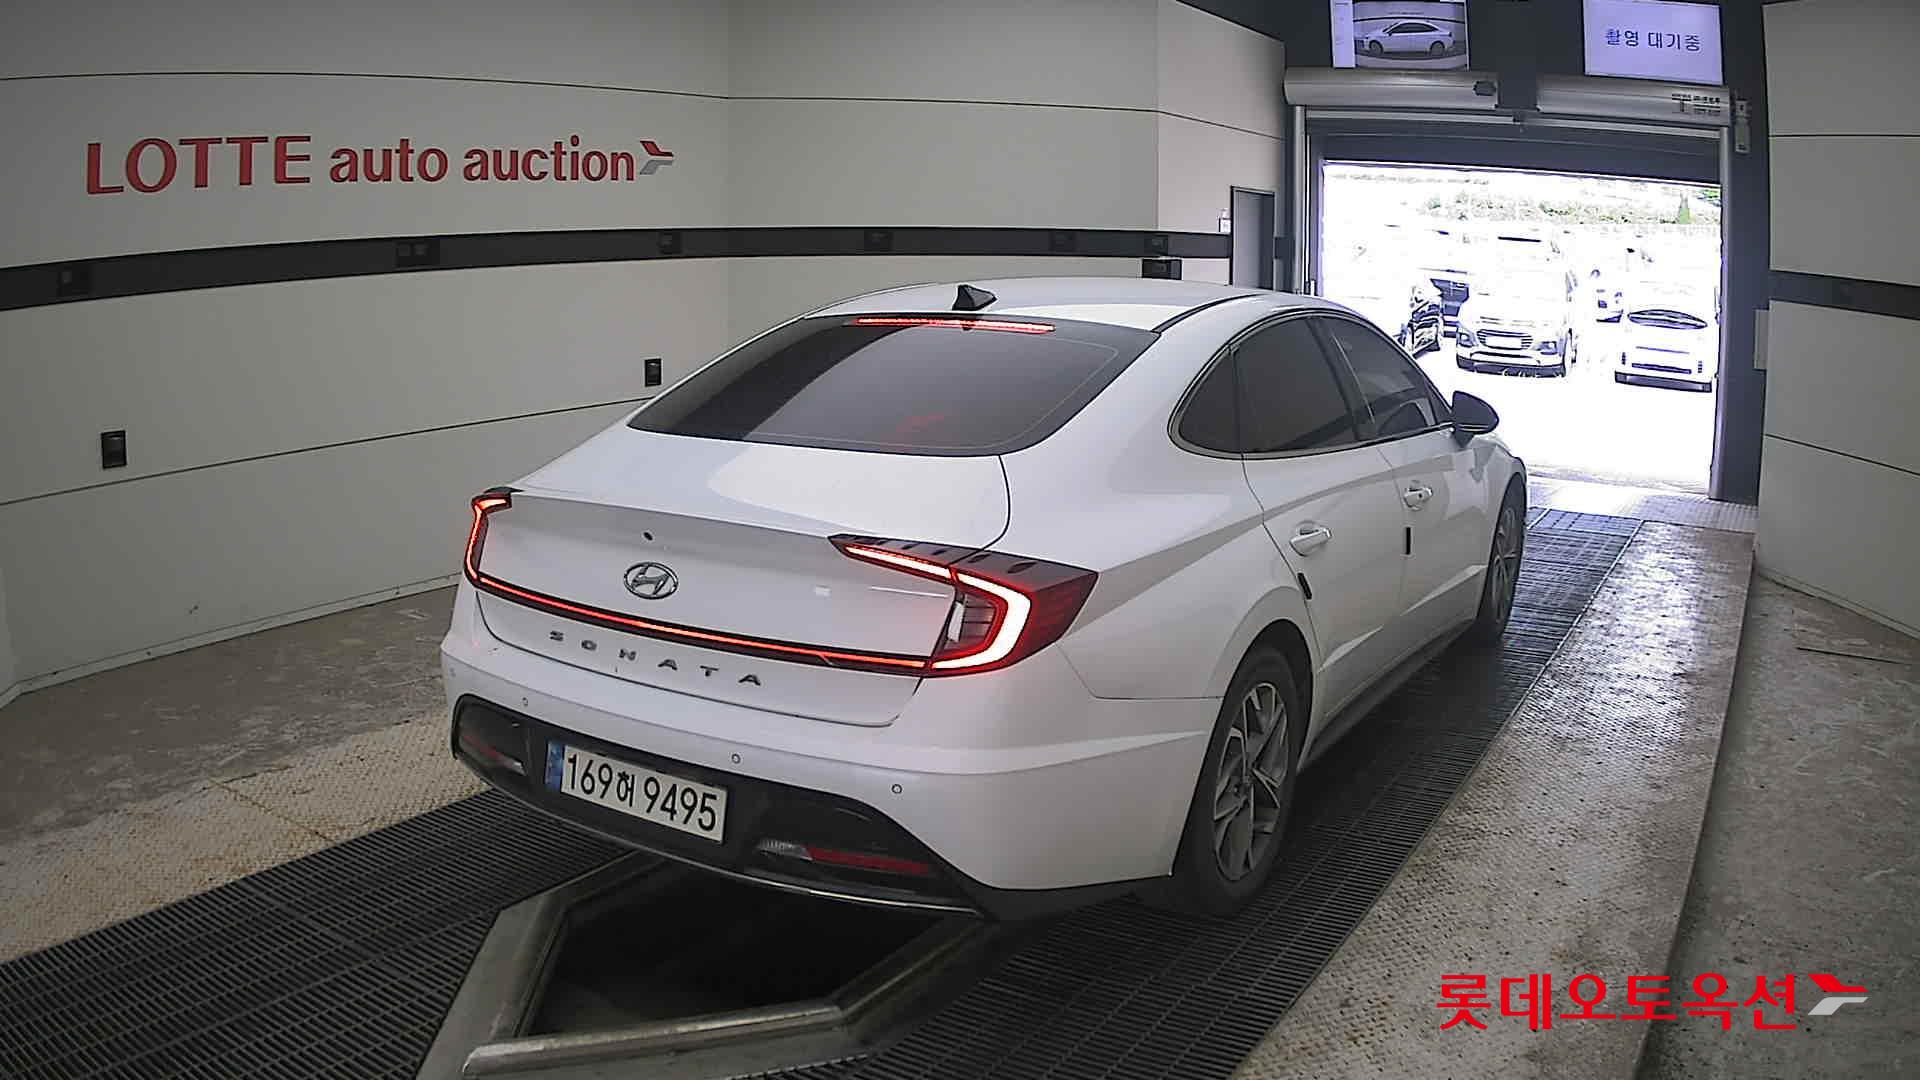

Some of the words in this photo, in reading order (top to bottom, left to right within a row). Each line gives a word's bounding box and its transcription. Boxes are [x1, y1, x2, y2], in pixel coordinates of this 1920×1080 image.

[1606, 28, 1639, 47] 촬영
[87, 135, 312, 194] LOTTE
[330, 138, 449, 182] auto
[462, 135, 636, 182] auction
[549, 630, 761, 686] SONATA
